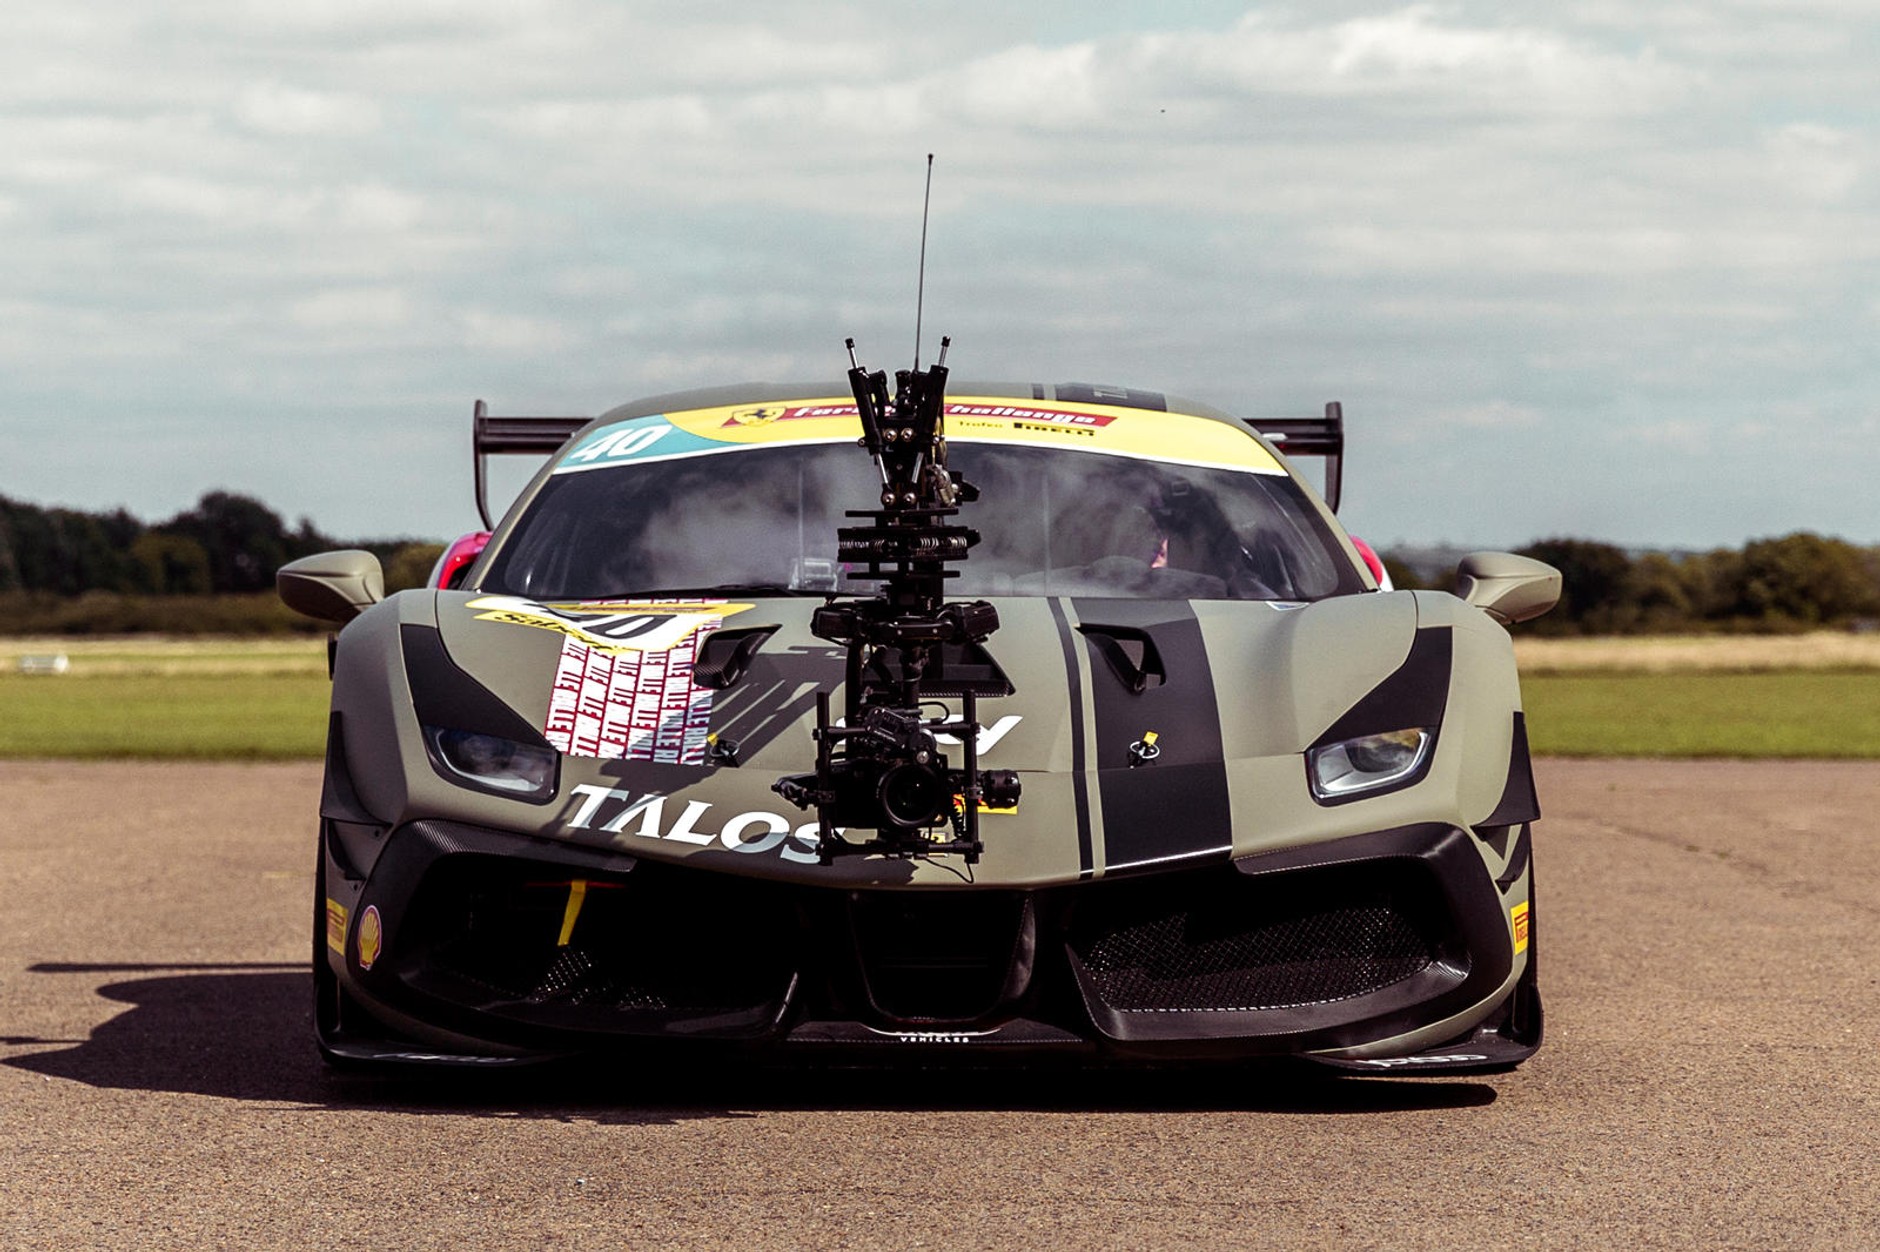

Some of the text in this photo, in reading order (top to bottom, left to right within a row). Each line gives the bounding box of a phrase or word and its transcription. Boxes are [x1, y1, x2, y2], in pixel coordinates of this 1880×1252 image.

[944, 405, 1096, 423] hallenge
[570, 424, 673, 461] 40
[567, 784, 846, 865] TALOS
